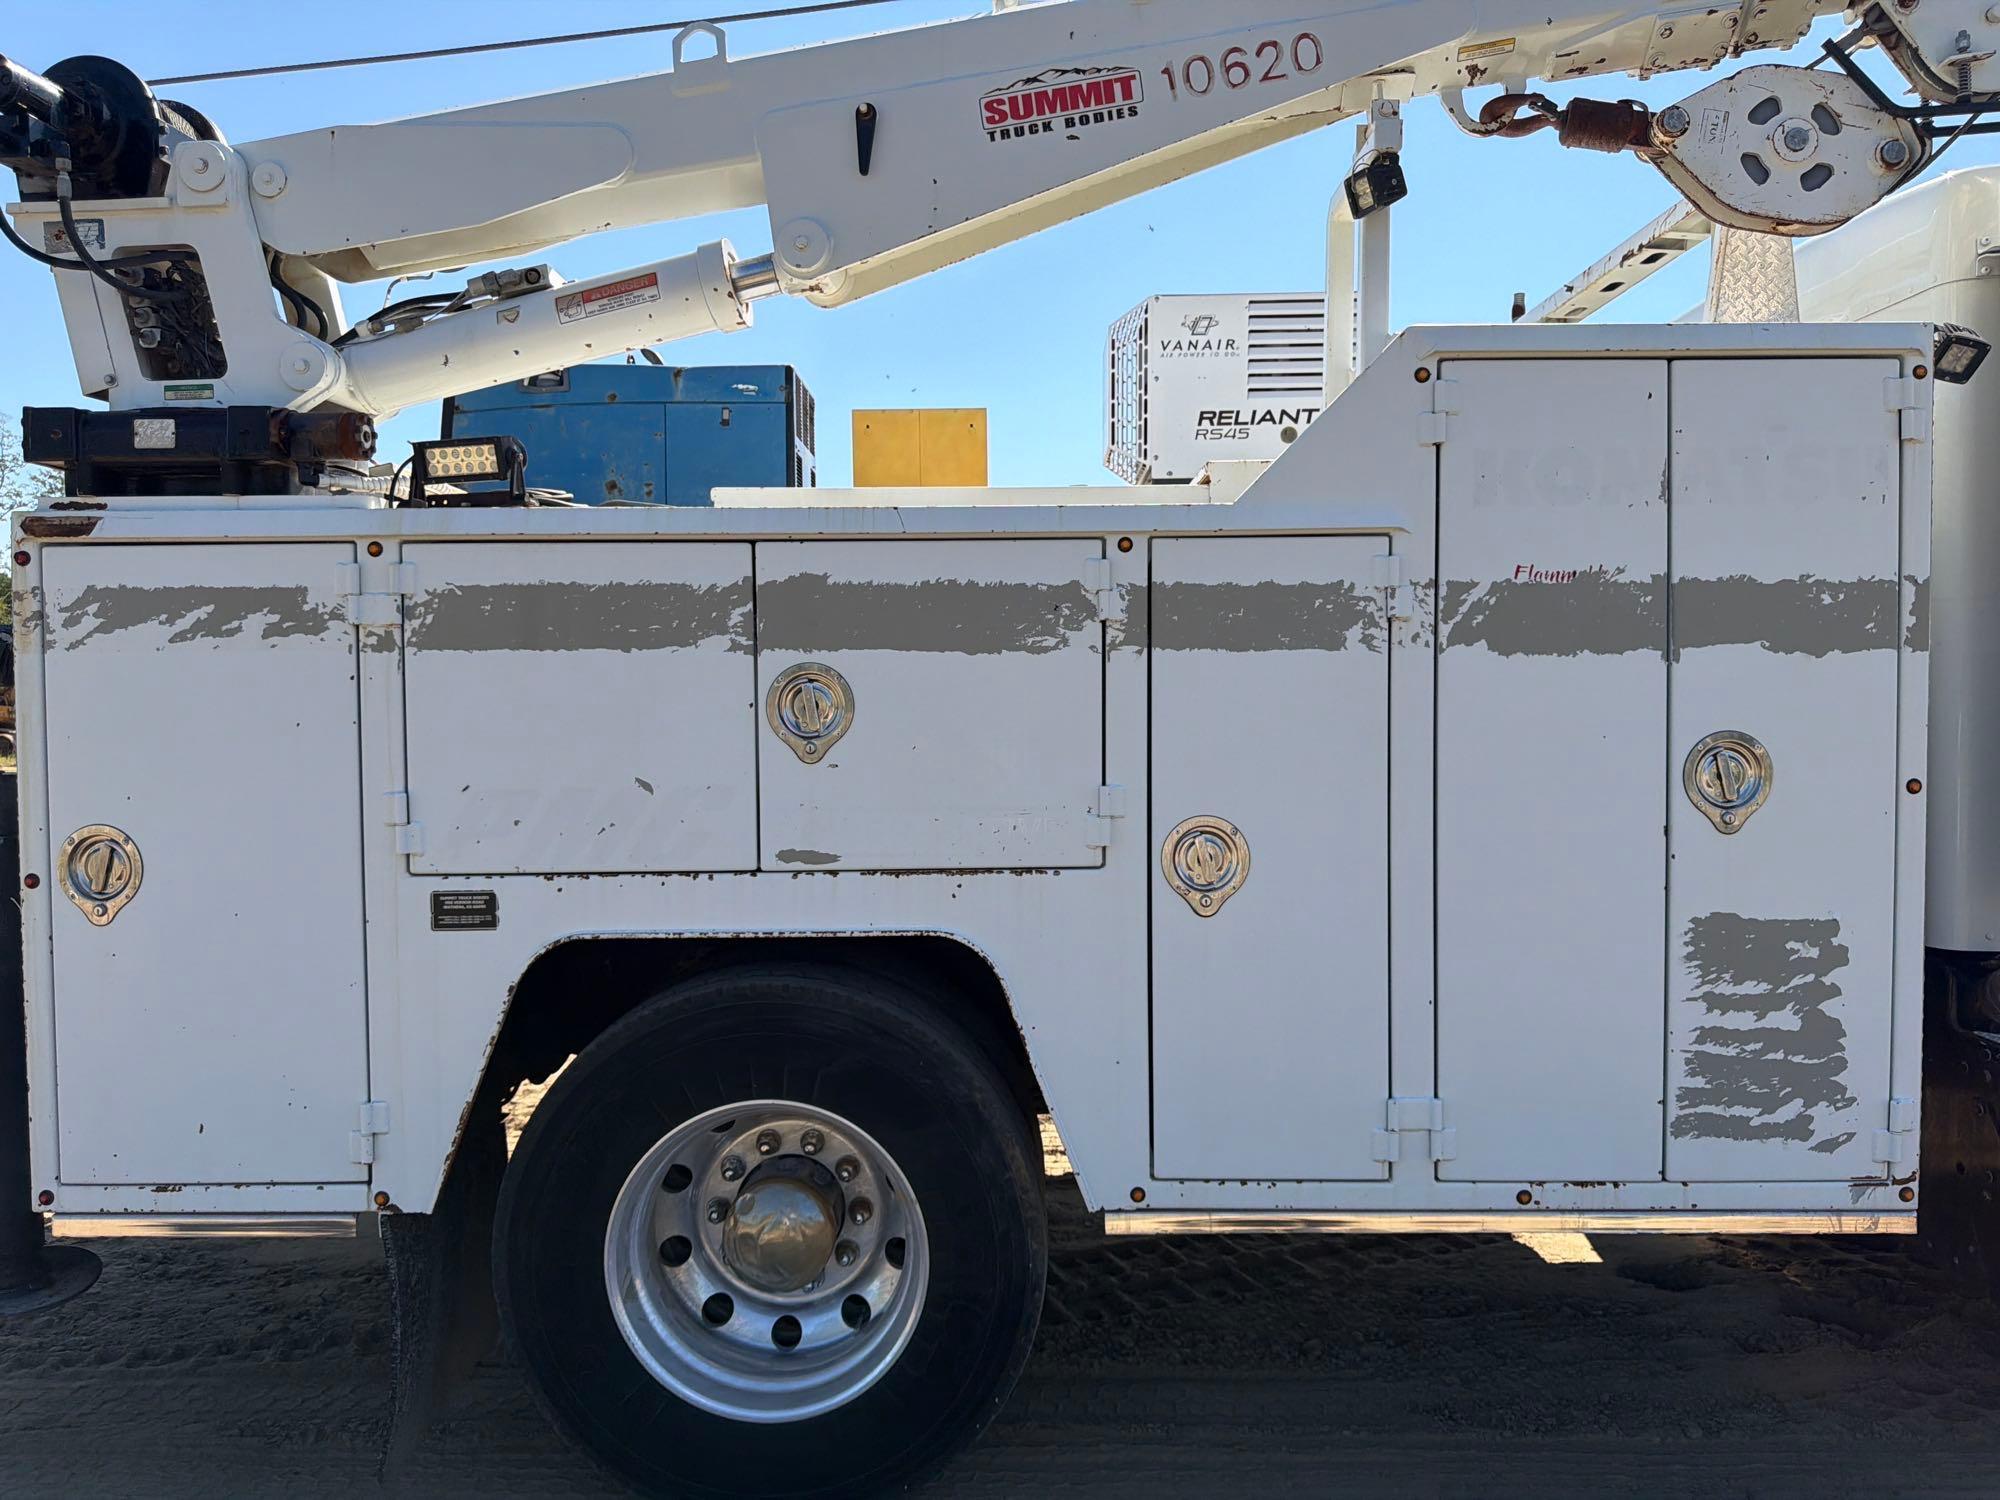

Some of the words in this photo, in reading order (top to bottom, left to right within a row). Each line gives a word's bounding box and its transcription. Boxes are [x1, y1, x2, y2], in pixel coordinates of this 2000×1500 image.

[1160, 32, 1324, 101] 10620
[983, 74, 1138, 126] SUMMIT
[987, 120, 1055, 143] TRUCK
[1064, 106, 1139, 130] BODIES
[601, 278, 649, 295] DANGER
[1161, 339, 1236, 351] VANAIR
[1197, 408, 1321, 427] RELIANT
[1194, 428, 1251, 441] RS45
